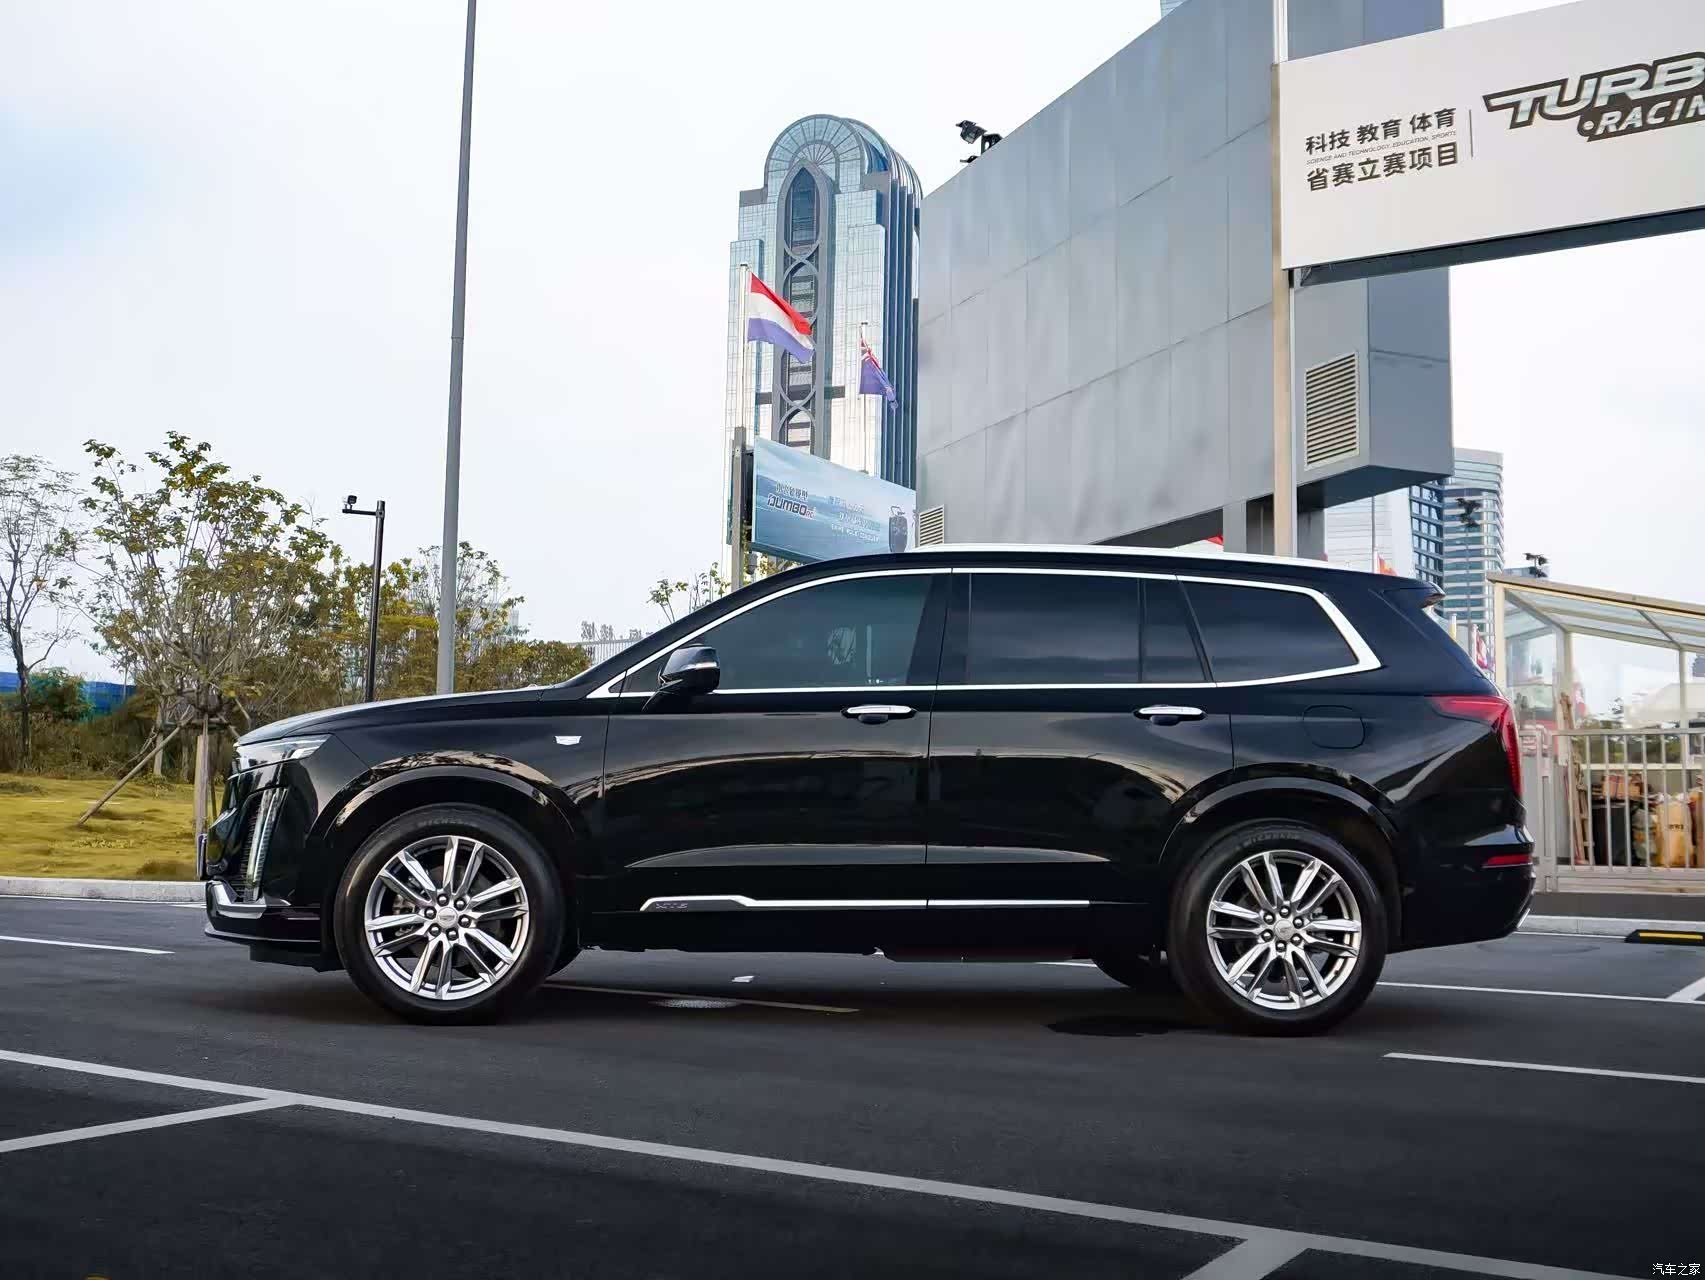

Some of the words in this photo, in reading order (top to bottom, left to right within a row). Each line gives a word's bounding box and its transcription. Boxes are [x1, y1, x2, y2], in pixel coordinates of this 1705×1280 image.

[1305, 129, 1351, 155] 科技
[1357, 118, 1402, 145] 教育
[1409, 107, 1457, 134] 体育
[1306, 155, 1332, 165] SCIENCE
[1333, 151, 1347, 159] AND
[1307, 141, 1458, 192] 省赛立赛项目
